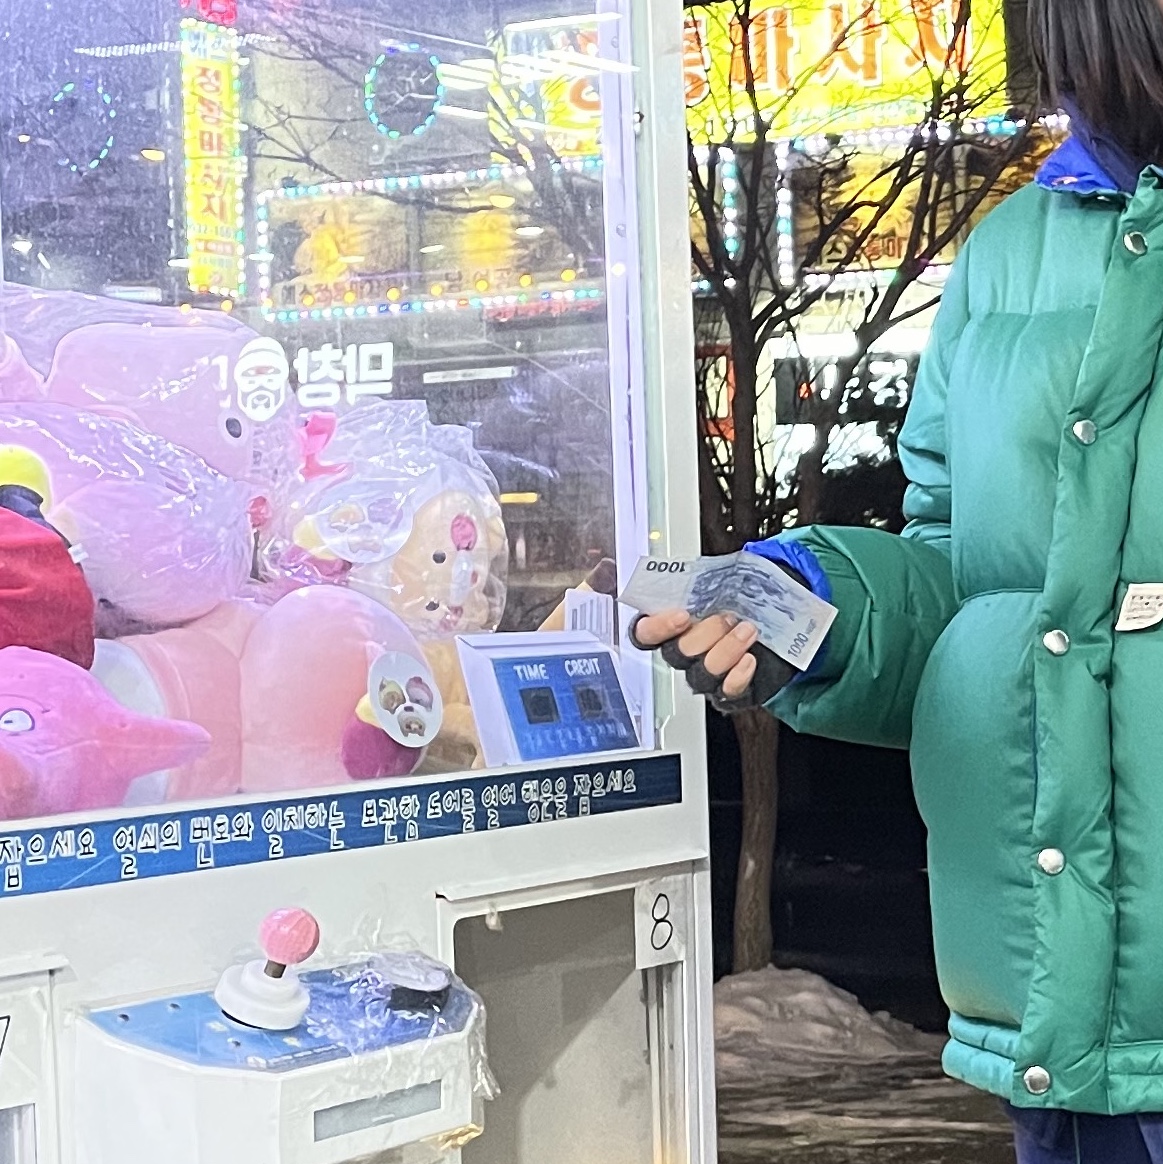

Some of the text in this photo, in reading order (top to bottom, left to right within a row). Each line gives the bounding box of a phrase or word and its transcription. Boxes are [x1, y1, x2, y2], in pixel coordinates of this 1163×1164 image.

[646, 560, 686, 573] 1000
[786, 632, 810, 659] 1000
[513, 657, 601, 681] TIME CREDIT
[0, 769, 637, 891] 잡으세요 열쇠의 번호와 일치하는 보관함 도어를 열어 행운을 잡으세요
[651, 893, 673, 950] 8
